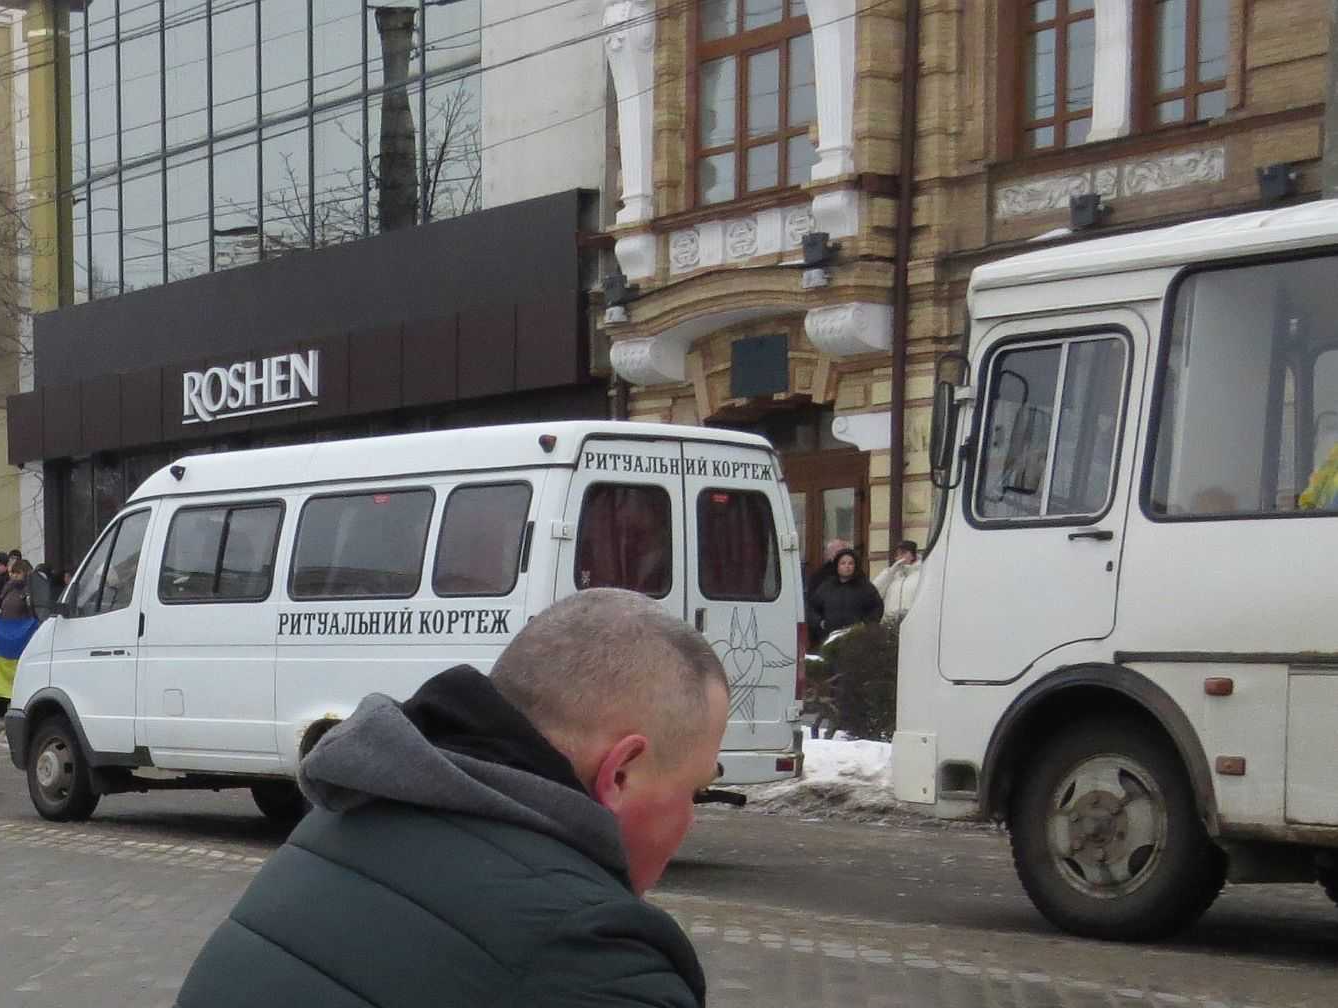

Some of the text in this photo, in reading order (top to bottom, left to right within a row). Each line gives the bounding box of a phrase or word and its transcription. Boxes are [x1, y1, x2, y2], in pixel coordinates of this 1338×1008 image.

[183, 350, 319, 422] ROSHEN
[584, 451, 774, 481] РИТУАЛЬНИЙ КОРТЕЖ
[277, 607, 511, 636] РИТУАЛЬНИЙ КОРТЕЖ
